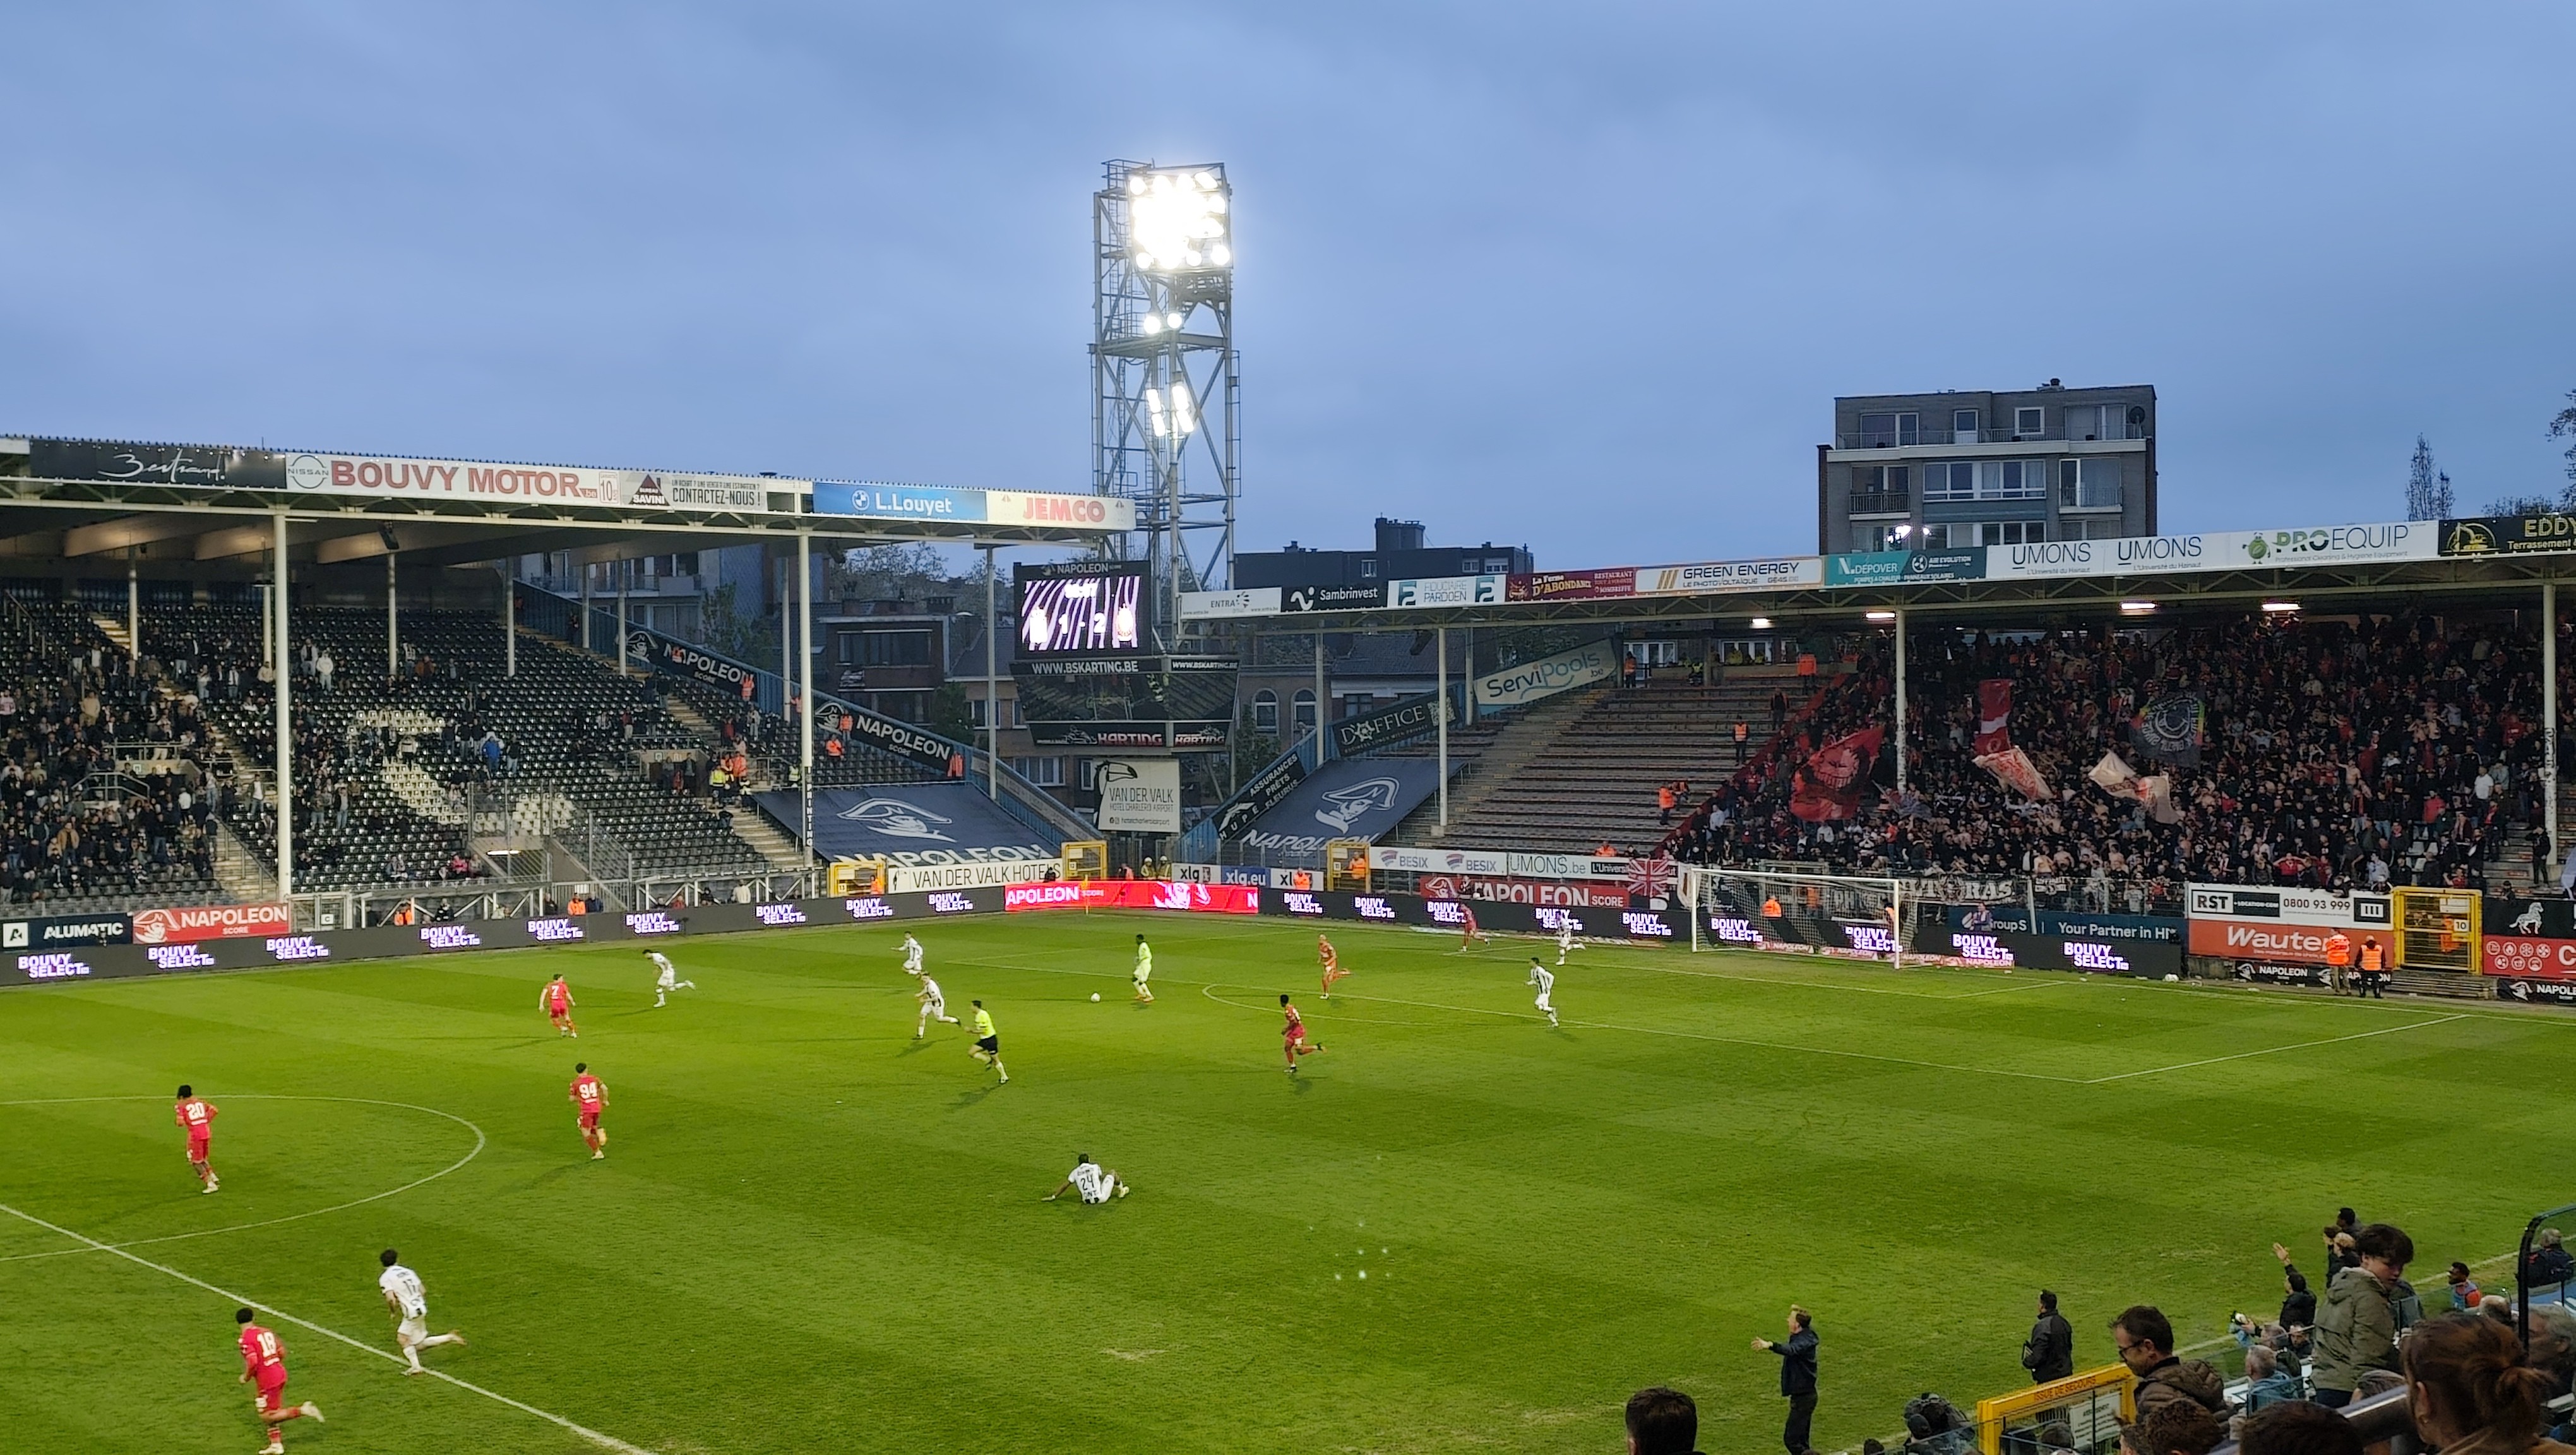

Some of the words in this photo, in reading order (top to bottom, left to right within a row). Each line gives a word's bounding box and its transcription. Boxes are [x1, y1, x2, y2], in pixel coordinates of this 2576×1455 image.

[287, 467, 329, 476] NISSAN
[331, 460, 460, 491] BOUVY
[468, 467, 581, 498] MOTOR
[633, 494, 665, 505] SAVINI
[672, 488, 754, 505] CONTACTEZ-NOUS
[875, 492, 953, 516] L.Louyet
[1023, 497, 1106, 523] JEMCO
[2275, 525, 2408, 553] PROEQUIP
[2507, 538, 2571, 550] Terrassement
[2013, 542, 2090, 566] UMONS
[2118, 536, 2202, 562] UMONS
[1057, 563, 1109, 574] NAPOLEON
[1683, 566, 1732, 579] GREEN
[1738, 562, 1799, 576] ENERGY
[1320, 587, 1378, 601] Sambrinvest
[1211, 600, 1235, 608] ENTRA
[1058, 613, 1068, 635] 1
[1093, 613, 1106, 633] 2
[1032, 661, 1138, 674] WWW.BSKARTING.BE
[857, 715, 950, 760] NAPOLEON
[1098, 733, 1162, 745] KARTING
[1175, 736, 1224, 745] KARTING
[1249, 753, 1297, 797] ASSURANCES
[1265, 773, 1290, 796] PRÊTS
[1109, 787, 1128, 802] VAN
[1130, 787, 1148, 802] DER
[1150, 788, 1174, 803] VALK
[1400, 856, 1428, 868] BESIX
[1466, 860, 1497, 872] BESIX
[1510, 856, 1586, 875] UMONS.be
[913, 870, 944, 889] VAN
[946, 868, 972, 886] DER
[976, 866, 1009, 884] VALK
[1180, 866, 1200, 883] xlg
[1225, 870, 1266, 887] xlg.eu
[846, 898, 880, 911] BOUVY
[929, 892, 962, 905] BOUVY
[1248, 892, 1258, 907] N
[1284, 893, 1312, 904] BOUVY
[1355, 897, 1385, 908] BOUVY
[1592, 895, 1623, 907] SCORE
[2197, 895, 2229, 910] RST
[2283, 898, 2310, 908] 0800
[2313, 899, 2327, 909] 93
[2330, 901, 2351, 911] 999
[756, 904, 792, 917] BOUVY
[853, 906, 888, 918] SELECT
[935, 900, 969, 912] SELECT
[1289, 901, 1318, 913] SELECT
[1361, 906, 1390, 918] SELECT
[1428, 901, 1458, 913] BOUVY
[181, 906, 288, 928] NAPOLEON
[626, 913, 665, 926] BOUVY
[763, 913, 801, 925] SELECT
[1623, 913, 1659, 925] BOUVY
[44, 922, 124, 940] ALUMATIC
[222, 926, 249, 935] SCORE
[528, 919, 569, 933] BOUVY
[635, 921, 673, 933] SELECT
[1630, 922, 1667, 935] SELECT
[1711, 918, 1750, 931] BOUVY
[2058, 921, 2087, 935] Your
[2089, 923, 2137, 938] Partner
[2139, 925, 2152, 939] in
[2455, 921, 2467, 930] 10
[420, 925, 465, 940] BOUVY
[536, 928, 577, 940] SELECT
[1719, 929, 1758, 942] SELECT
[266, 937, 313, 951] BOUVY
[430, 934, 475, 948] SELECT
[1952, 934, 1998, 948] BOUVY
[148, 945, 197, 960] BOUVY
[276, 945, 323, 959] SELECT
[1962, 946, 2007, 960] SELECT
[2064, 942, 2111, 956] BOUVY
[18, 954, 71, 969] BOUVY
[158, 954, 208, 968] SELECT
[2073, 954, 2121, 969] SELECT
[29, 963, 83, 978] SELECT
[2260, 966, 2308, 977] NAPOLEON
[551, 985, 559, 996] 7
[578, 1081, 598, 1099] 94
[186, 1101, 206, 1121] 20
[1080, 1174, 1095, 1191] 24
[256, 1331, 277, 1358] 18
[2064, 1375, 2097, 1394] SECOURS
